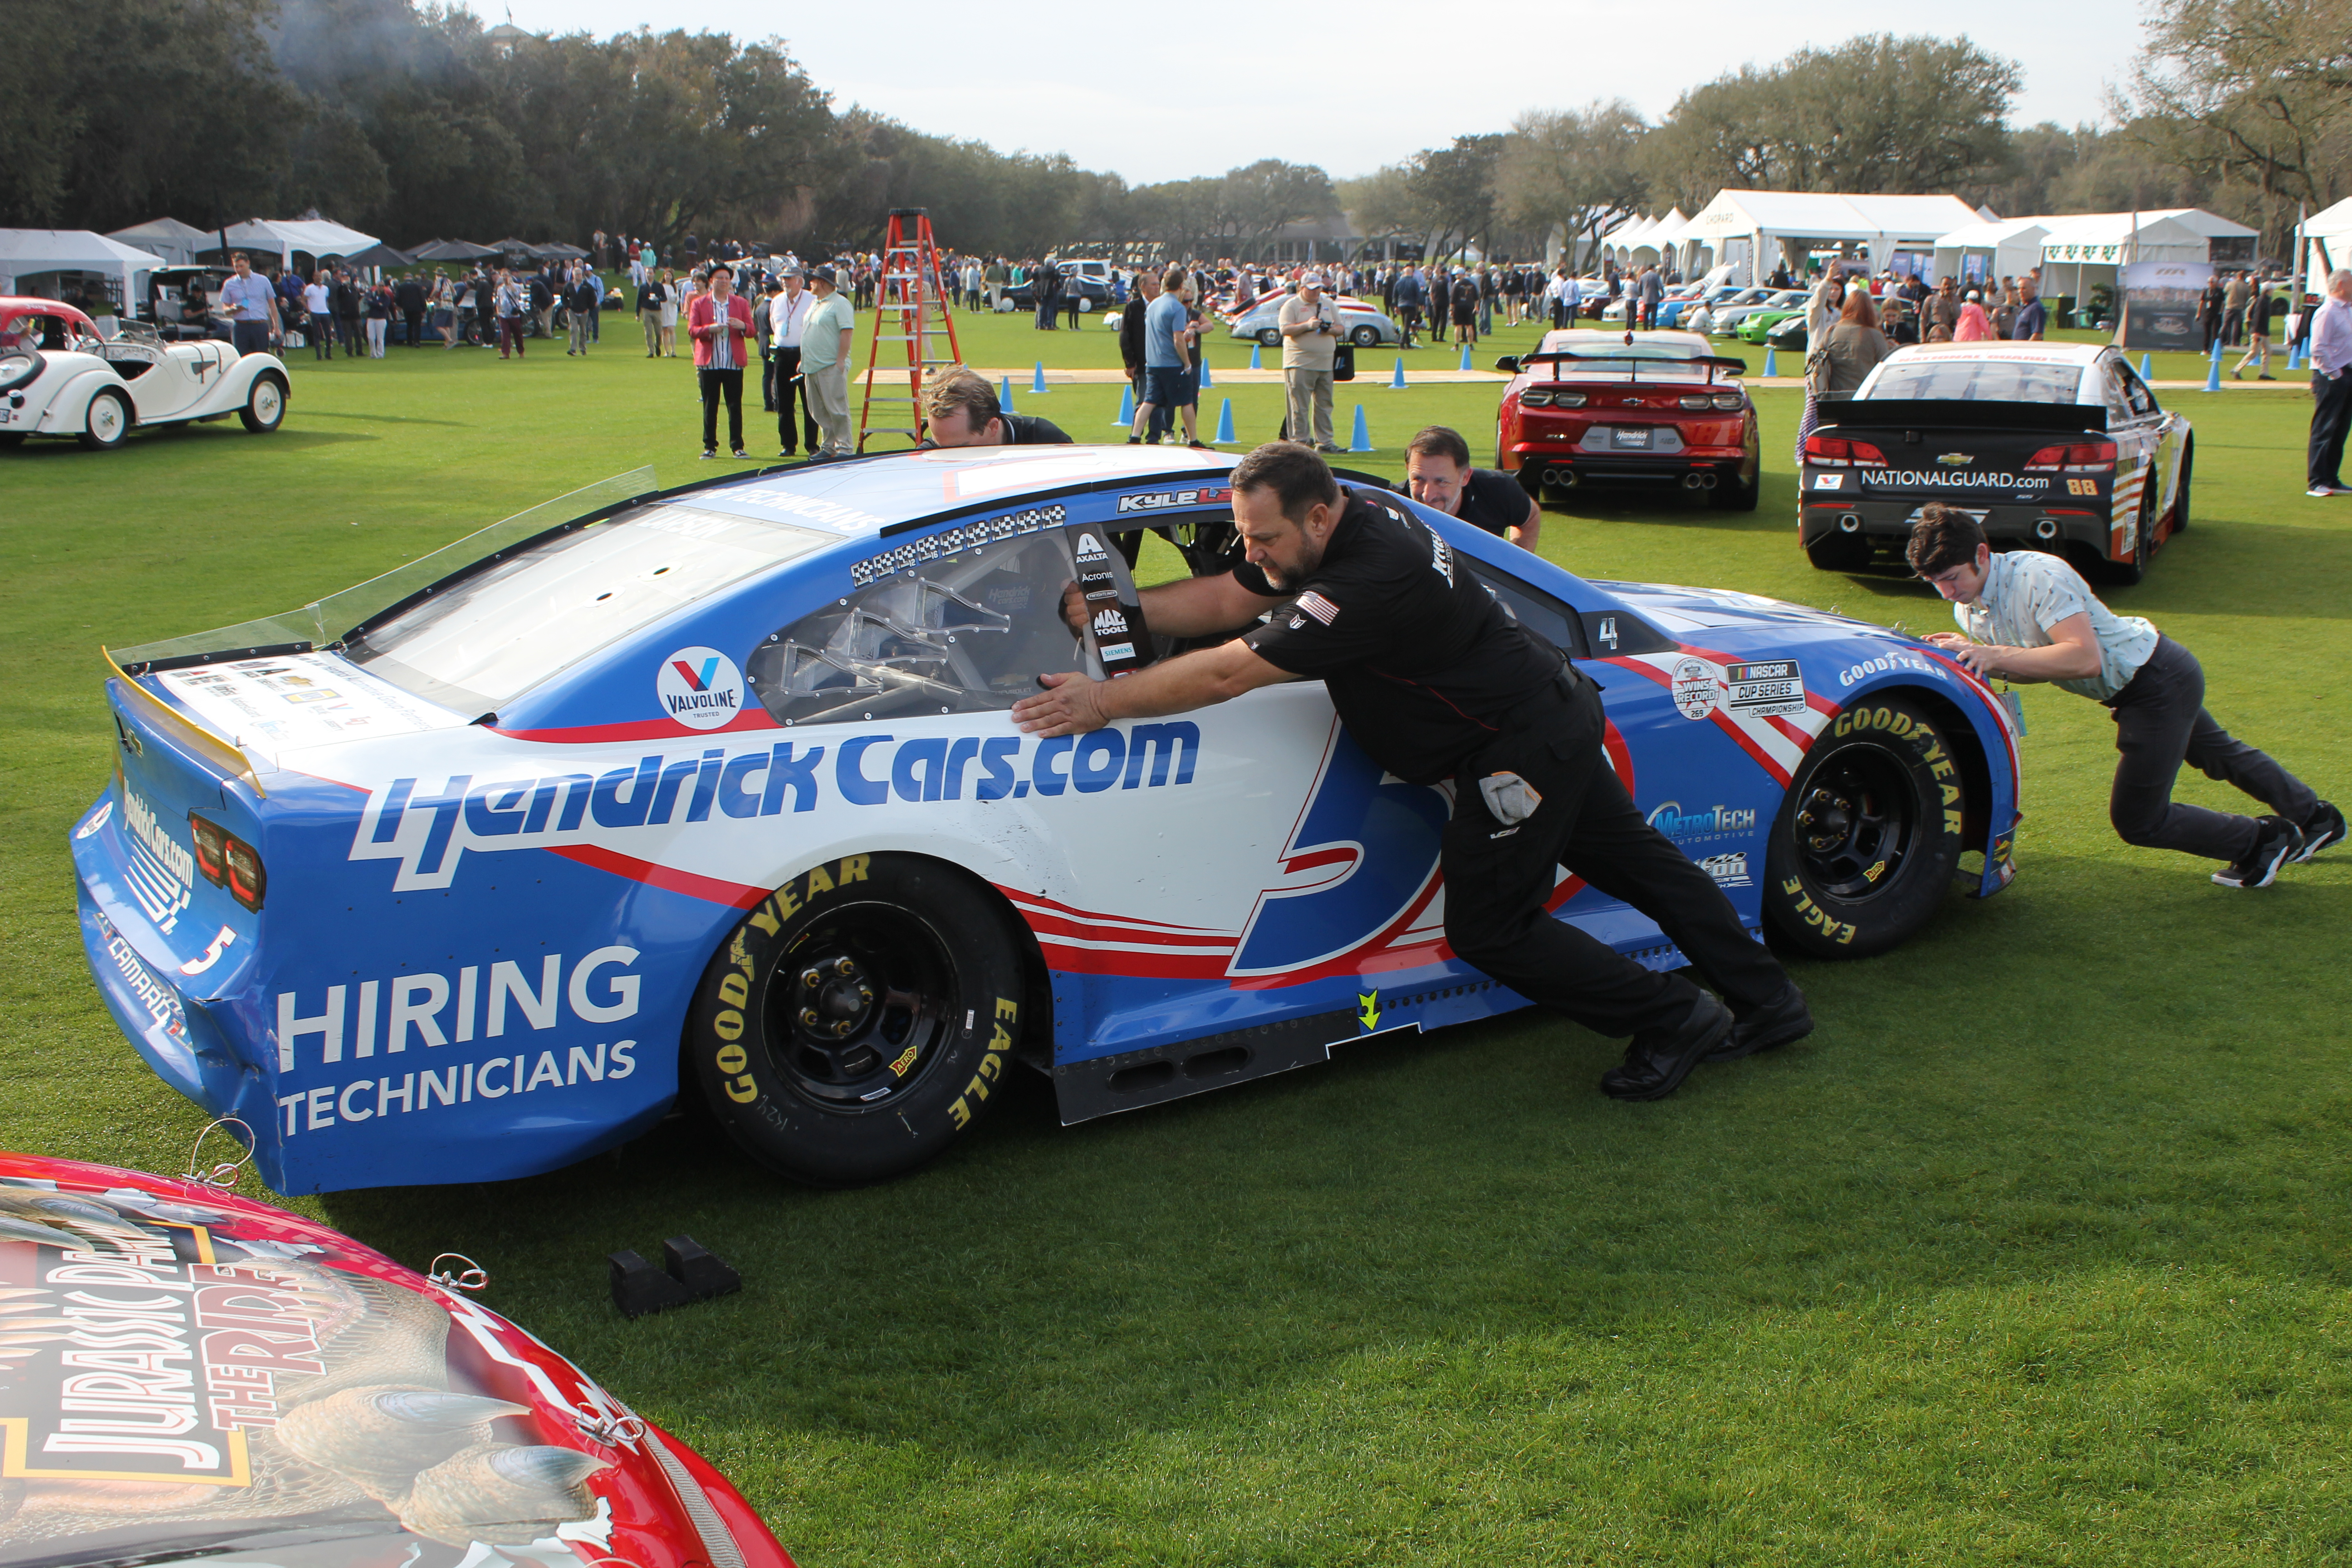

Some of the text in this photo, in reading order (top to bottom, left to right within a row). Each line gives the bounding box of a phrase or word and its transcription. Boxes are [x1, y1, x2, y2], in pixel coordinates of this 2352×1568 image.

[1706, 213, 1734, 225] CHOPARD
[1616, 431, 1649, 441] Hendrick
[1862, 470, 2049, 488] NATIONALGUARD.com
[2067, 479, 2097, 495] 88
[727, 489, 886, 531] TECHNICIANS
[909, 559, 916, 567] 12
[931, 550, 939, 559] 16
[1076, 553, 1108, 564] AXALTA
[868, 574, 874, 583] 8
[1082, 571, 1113, 582] Acronis
[1094, 609, 1127, 629] MAC
[1095, 625, 1128, 636] TOOLS
[1599, 617, 1618, 650] 4
[1105, 647, 1132, 657] SIEMENS
[1749, 664, 1788, 678] NASCAR
[1839, 652, 1949, 686] GOODYEAR
[994, 687, 1032, 696] HEVROLET
[1683, 680, 1710, 691] WINS
[1739, 683, 1792, 698] CUP SERIES
[666, 688, 737, 714] VALVOLINE
[1677, 690, 1715, 703] RECORD
[378, 695, 404, 710] Group
[397, 709, 433, 731] Partners
[1691, 710, 1703, 718] 269
[1752, 703, 1804, 715] CHAMPIONSHIP
[1834, 707, 1962, 834] GOODYEAR
[1869, 864, 1882, 879] AERO
[1783, 876, 1857, 945] EAGLE
[179, 924, 238, 976] 5
[108, 936, 172, 1027] CAMARO
[714, 853, 871, 1104] GOODYEAR
[277, 945, 642, 1074] HIRING
[897, 1051, 914, 1071] AERO
[947, 995, 1018, 1132] EAGLE
[279, 1039, 637, 1137] TECHNICIANS
[187, 1262, 328, 1432] THE RIDE
[43, 1289, 220, 1470] JURASSIC
